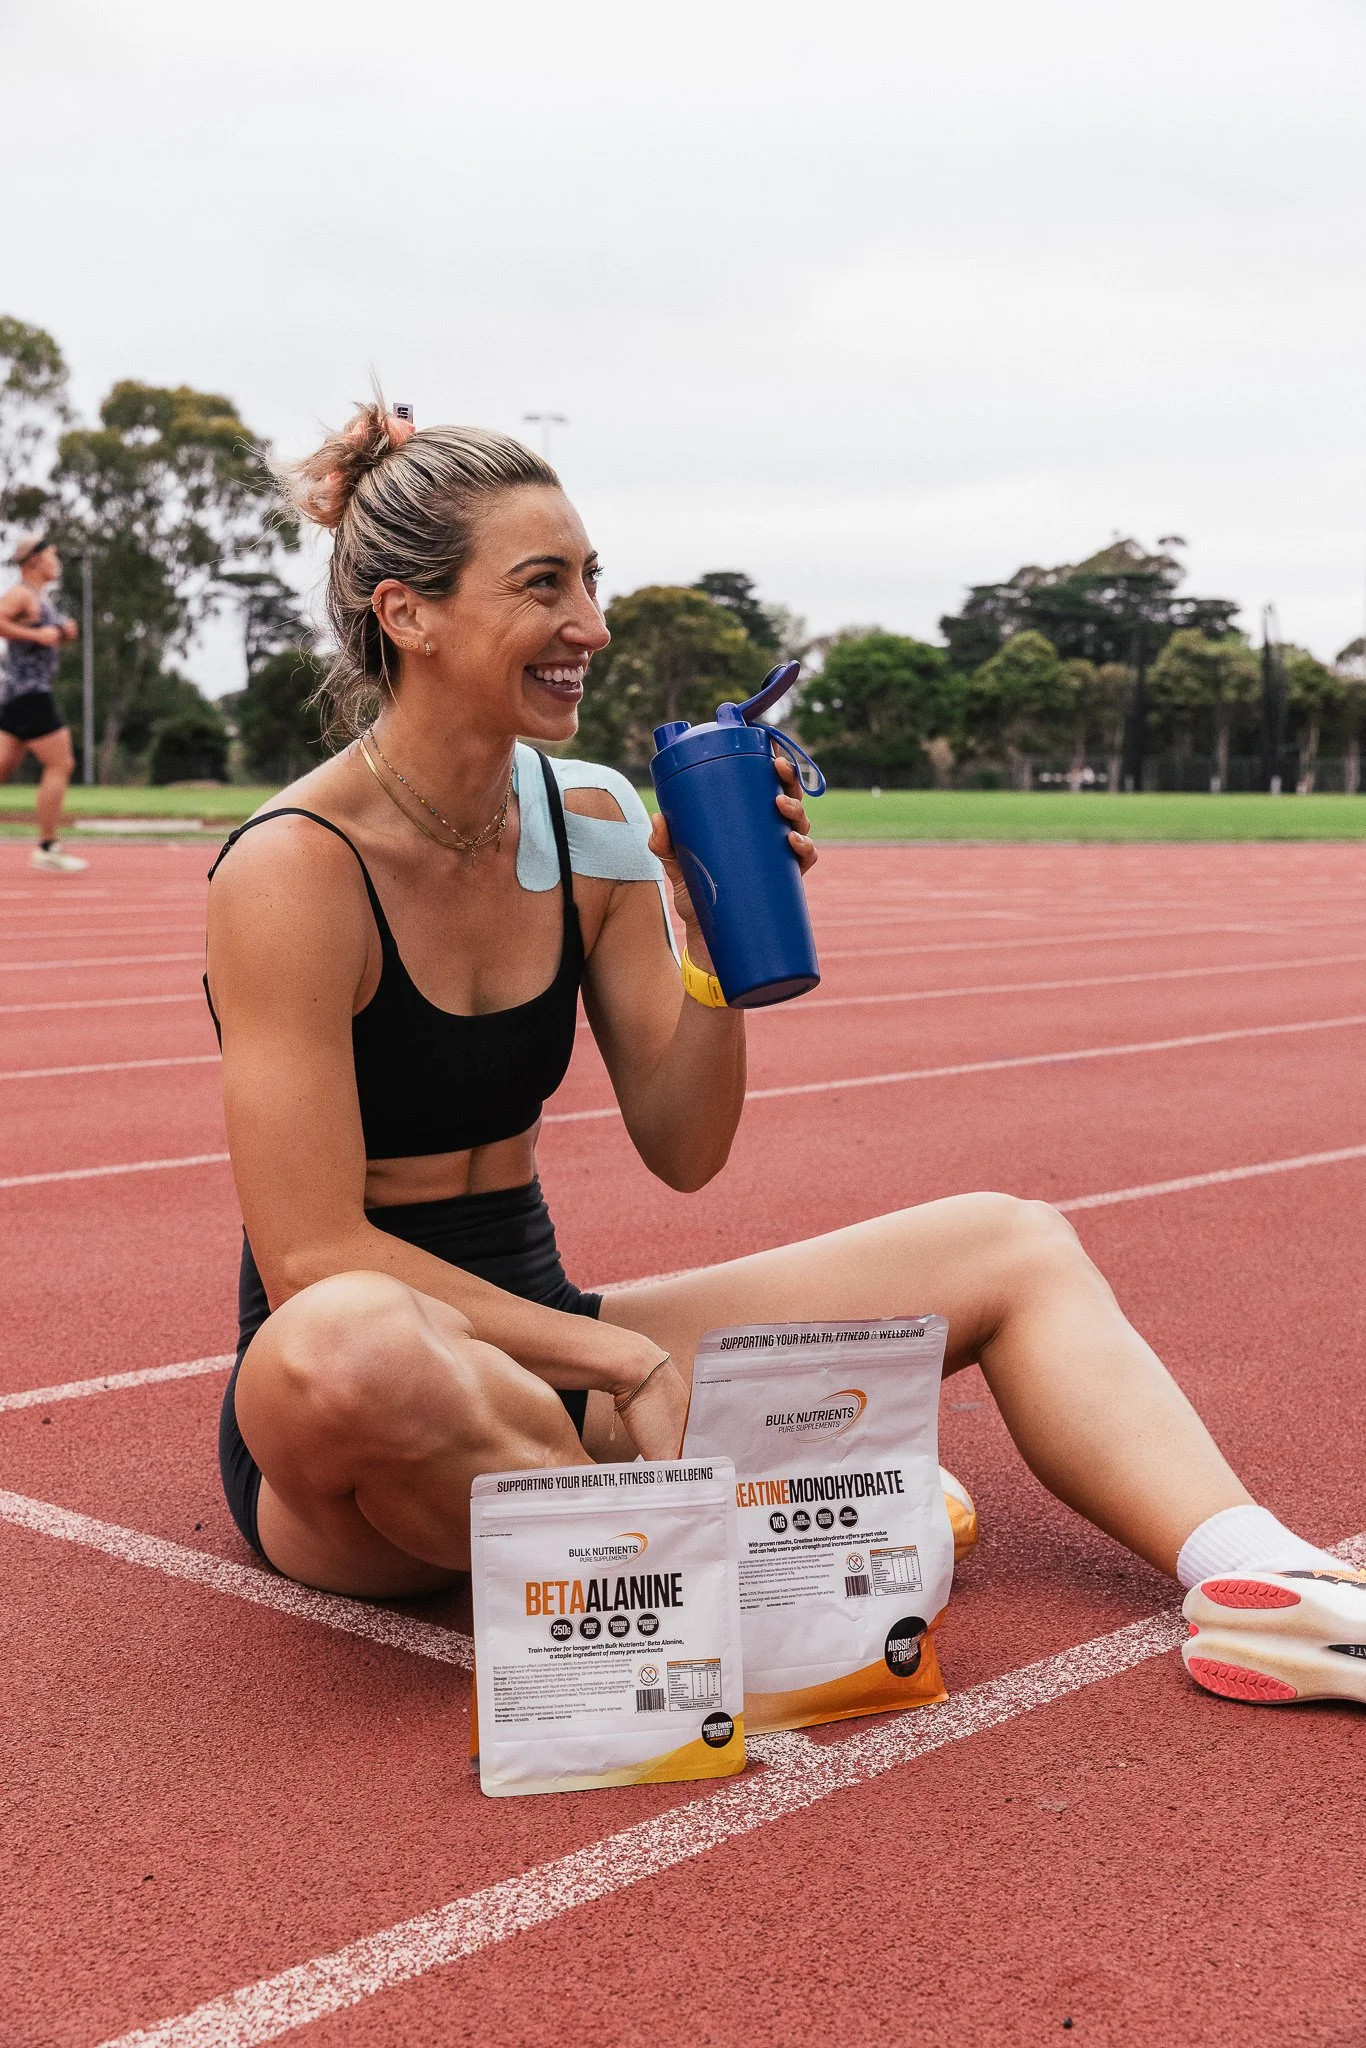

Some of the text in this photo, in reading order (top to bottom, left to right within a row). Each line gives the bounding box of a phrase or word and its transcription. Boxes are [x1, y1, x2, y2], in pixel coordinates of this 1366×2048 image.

[720, 1335, 774, 1350] SUPPORTING
[776, 1334, 799, 1346] YOUR
[800, 1333, 834, 1344] HEALTH,
[871, 1331, 877, 1339] &
[766, 1407, 855, 1426] BULK NUTRIENTS
[778, 1421, 840, 1433] PURE SUPPLEMENTS
[497, 1467, 713, 1492] SUPPORTING YOUR HEALTH, FITNESS & WELLBEING
[772, 1516, 785, 1529] 1KG
[568, 1545, 638, 1557] BULK NUTRIENTS
[892, 1651, 898, 1662] &
